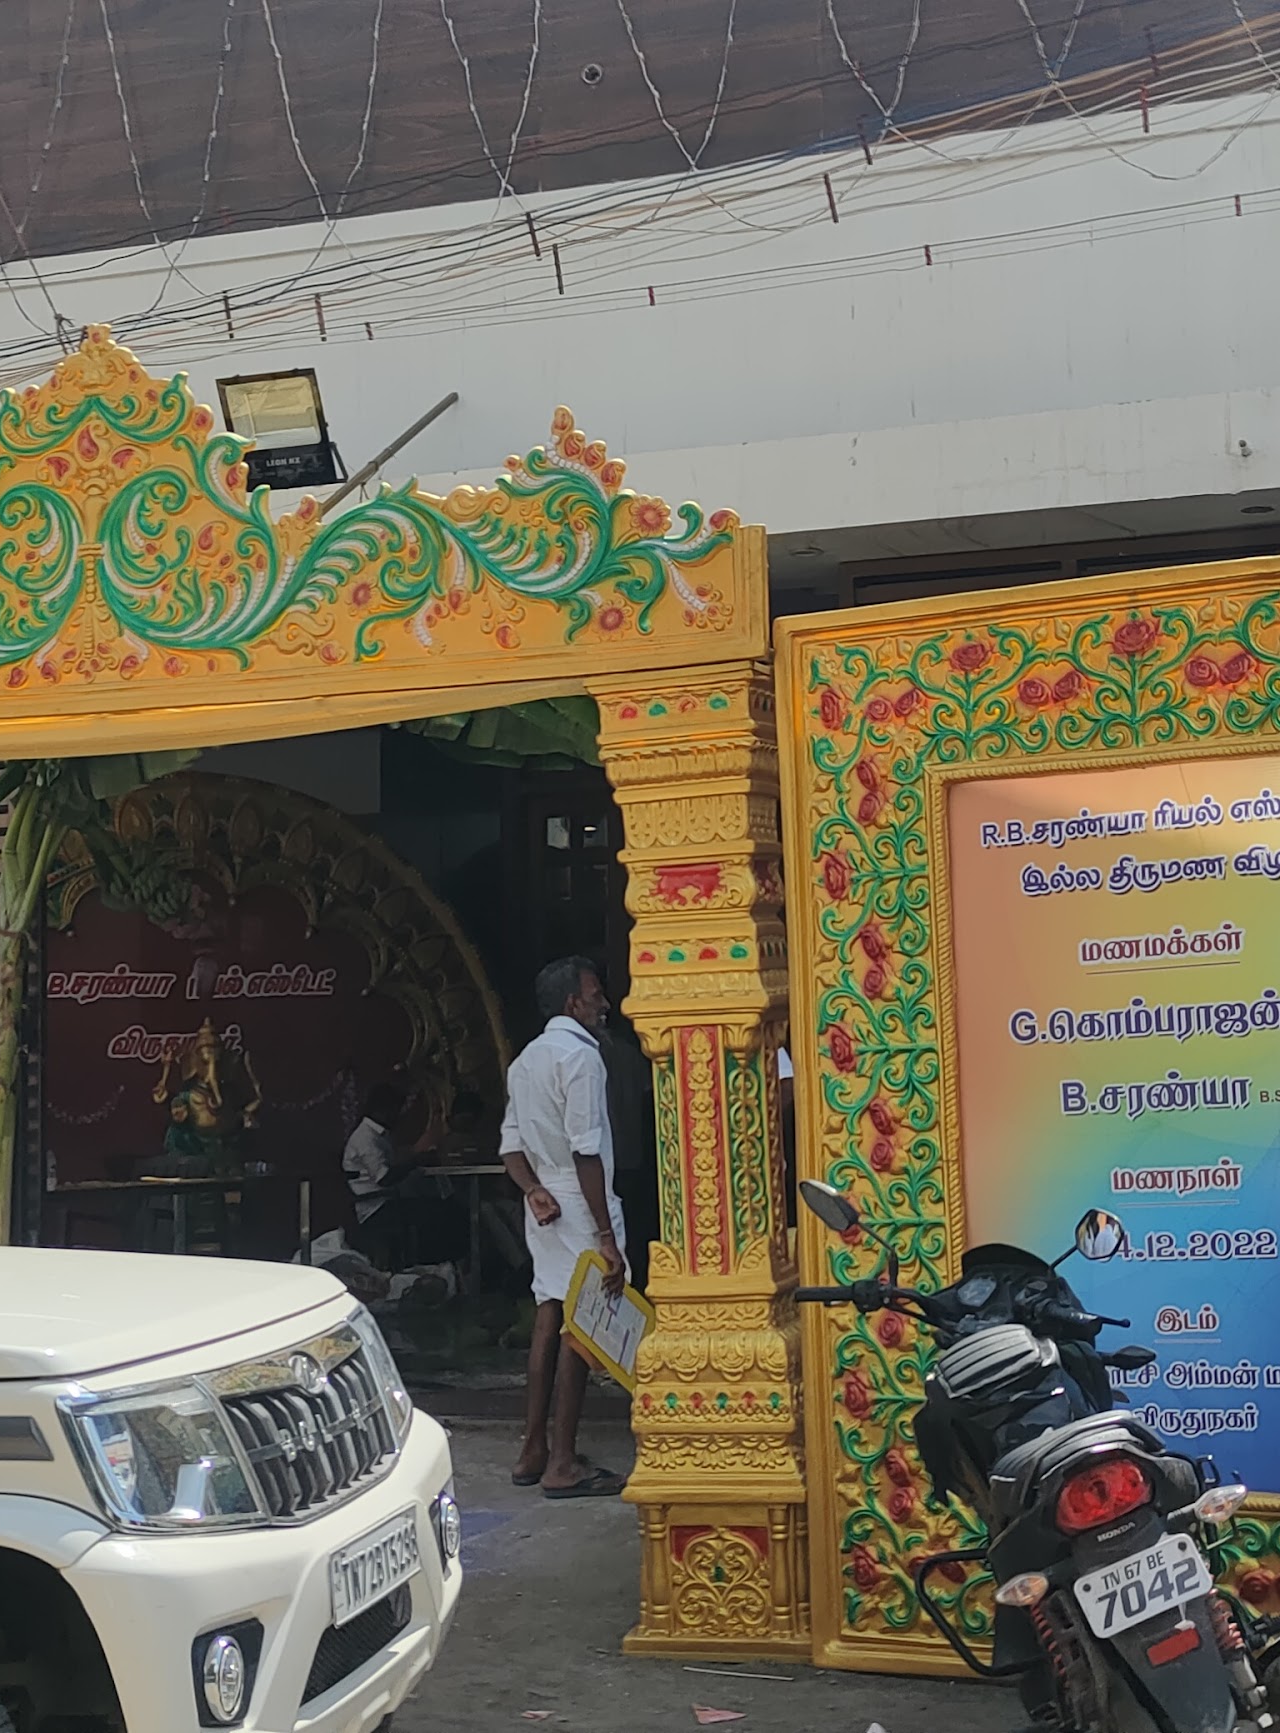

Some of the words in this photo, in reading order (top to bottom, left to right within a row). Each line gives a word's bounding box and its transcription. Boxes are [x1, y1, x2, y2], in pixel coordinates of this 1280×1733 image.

[981, 808, 1147, 848] R.B.சரண்யா
[1154, 795, 1223, 828] ரியல்
[1021, 861, 1102, 896] இல்ல
[1108, 854, 1226, 894] திருமண
[1078, 920, 1245, 965] மணமக்கள்
[1061, 1070, 1253, 1119] B.சரண்யா
[1110, 1157, 1243, 1196] மணநாள்
[1154, 1303, 1221, 1336] இடம்
[1164, 1360, 1260, 1391] அம்மன்
[1096, 1521, 1136, 1543] HONDA
[1100, 1568, 1122, 1591] TN
[1124, 1559, 1141, 1581] 67
[1146, 1550, 1166, 1571] BE
[1095, 1556, 1201, 1631] 7042
